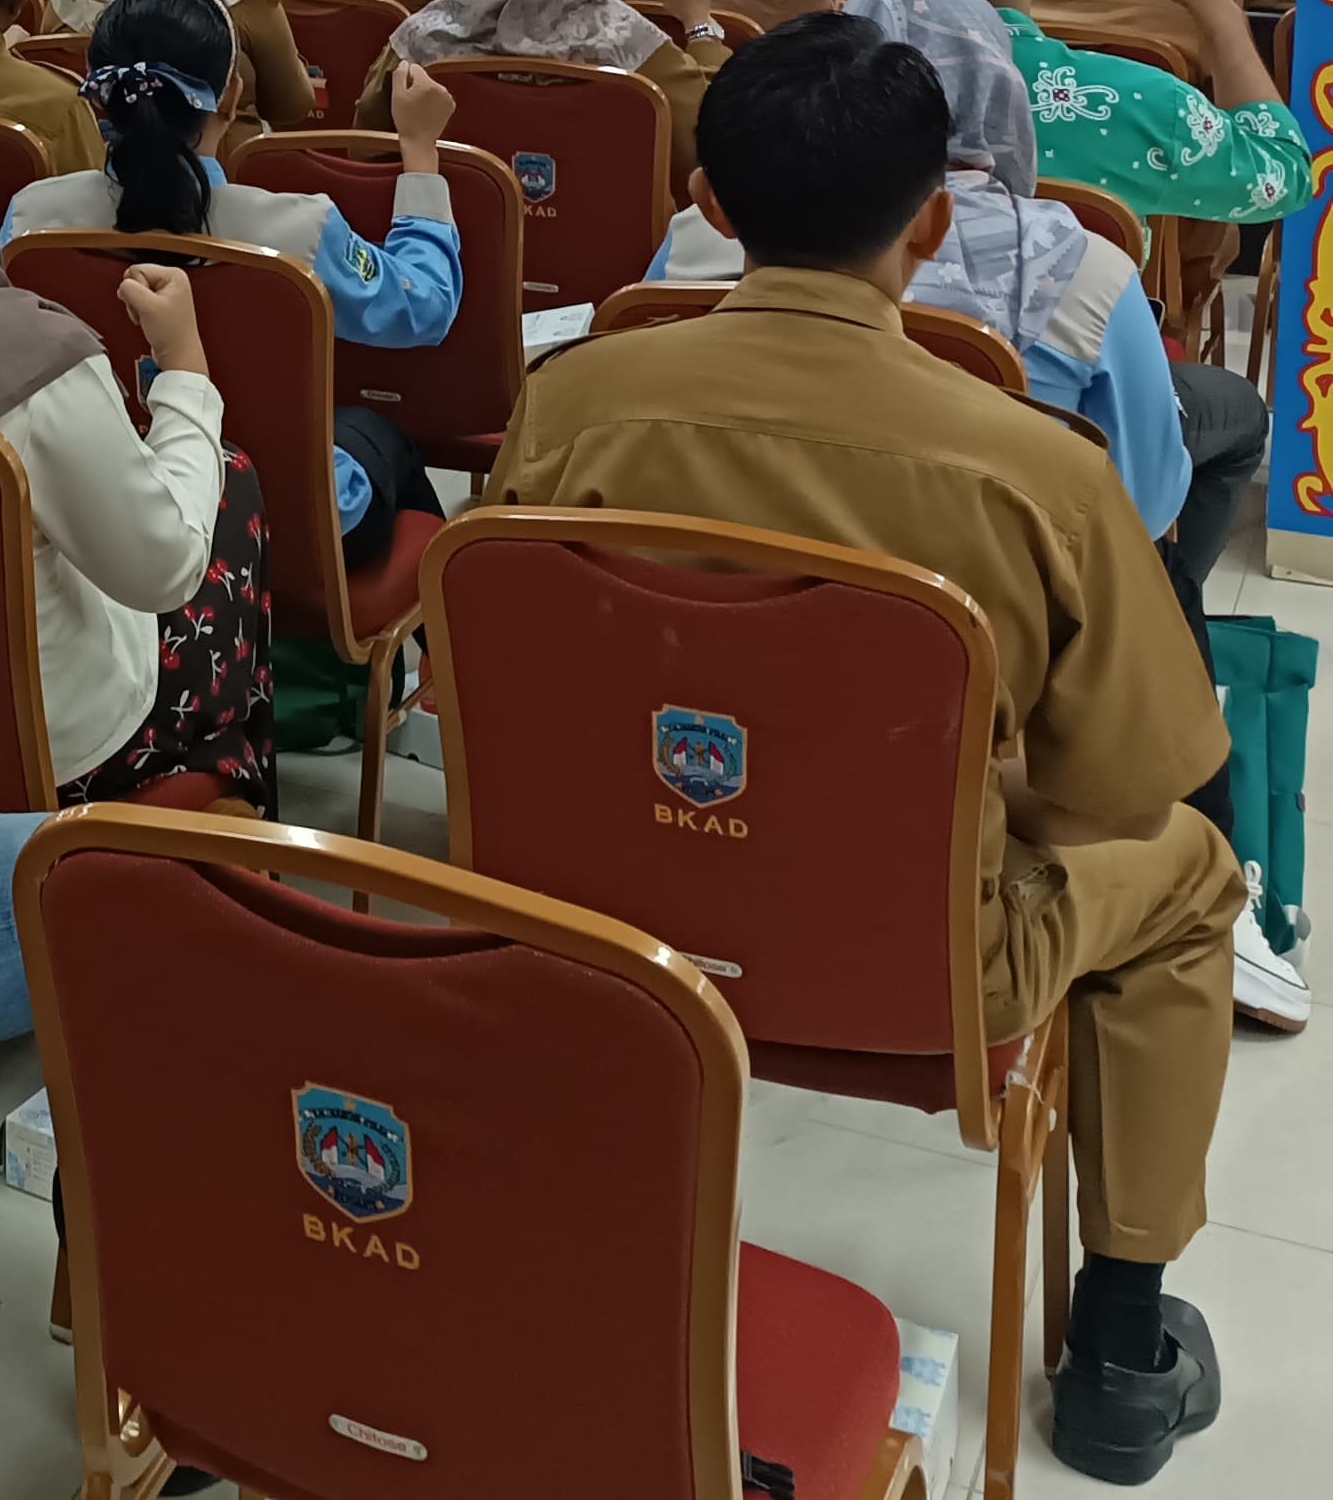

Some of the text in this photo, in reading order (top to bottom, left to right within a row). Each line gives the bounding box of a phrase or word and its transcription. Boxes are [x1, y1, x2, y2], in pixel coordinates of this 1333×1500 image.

[523, 203, 557, 218] KAD
[653, 802, 749, 839] BKAD
[302, 1212, 421, 1271] BKAD
